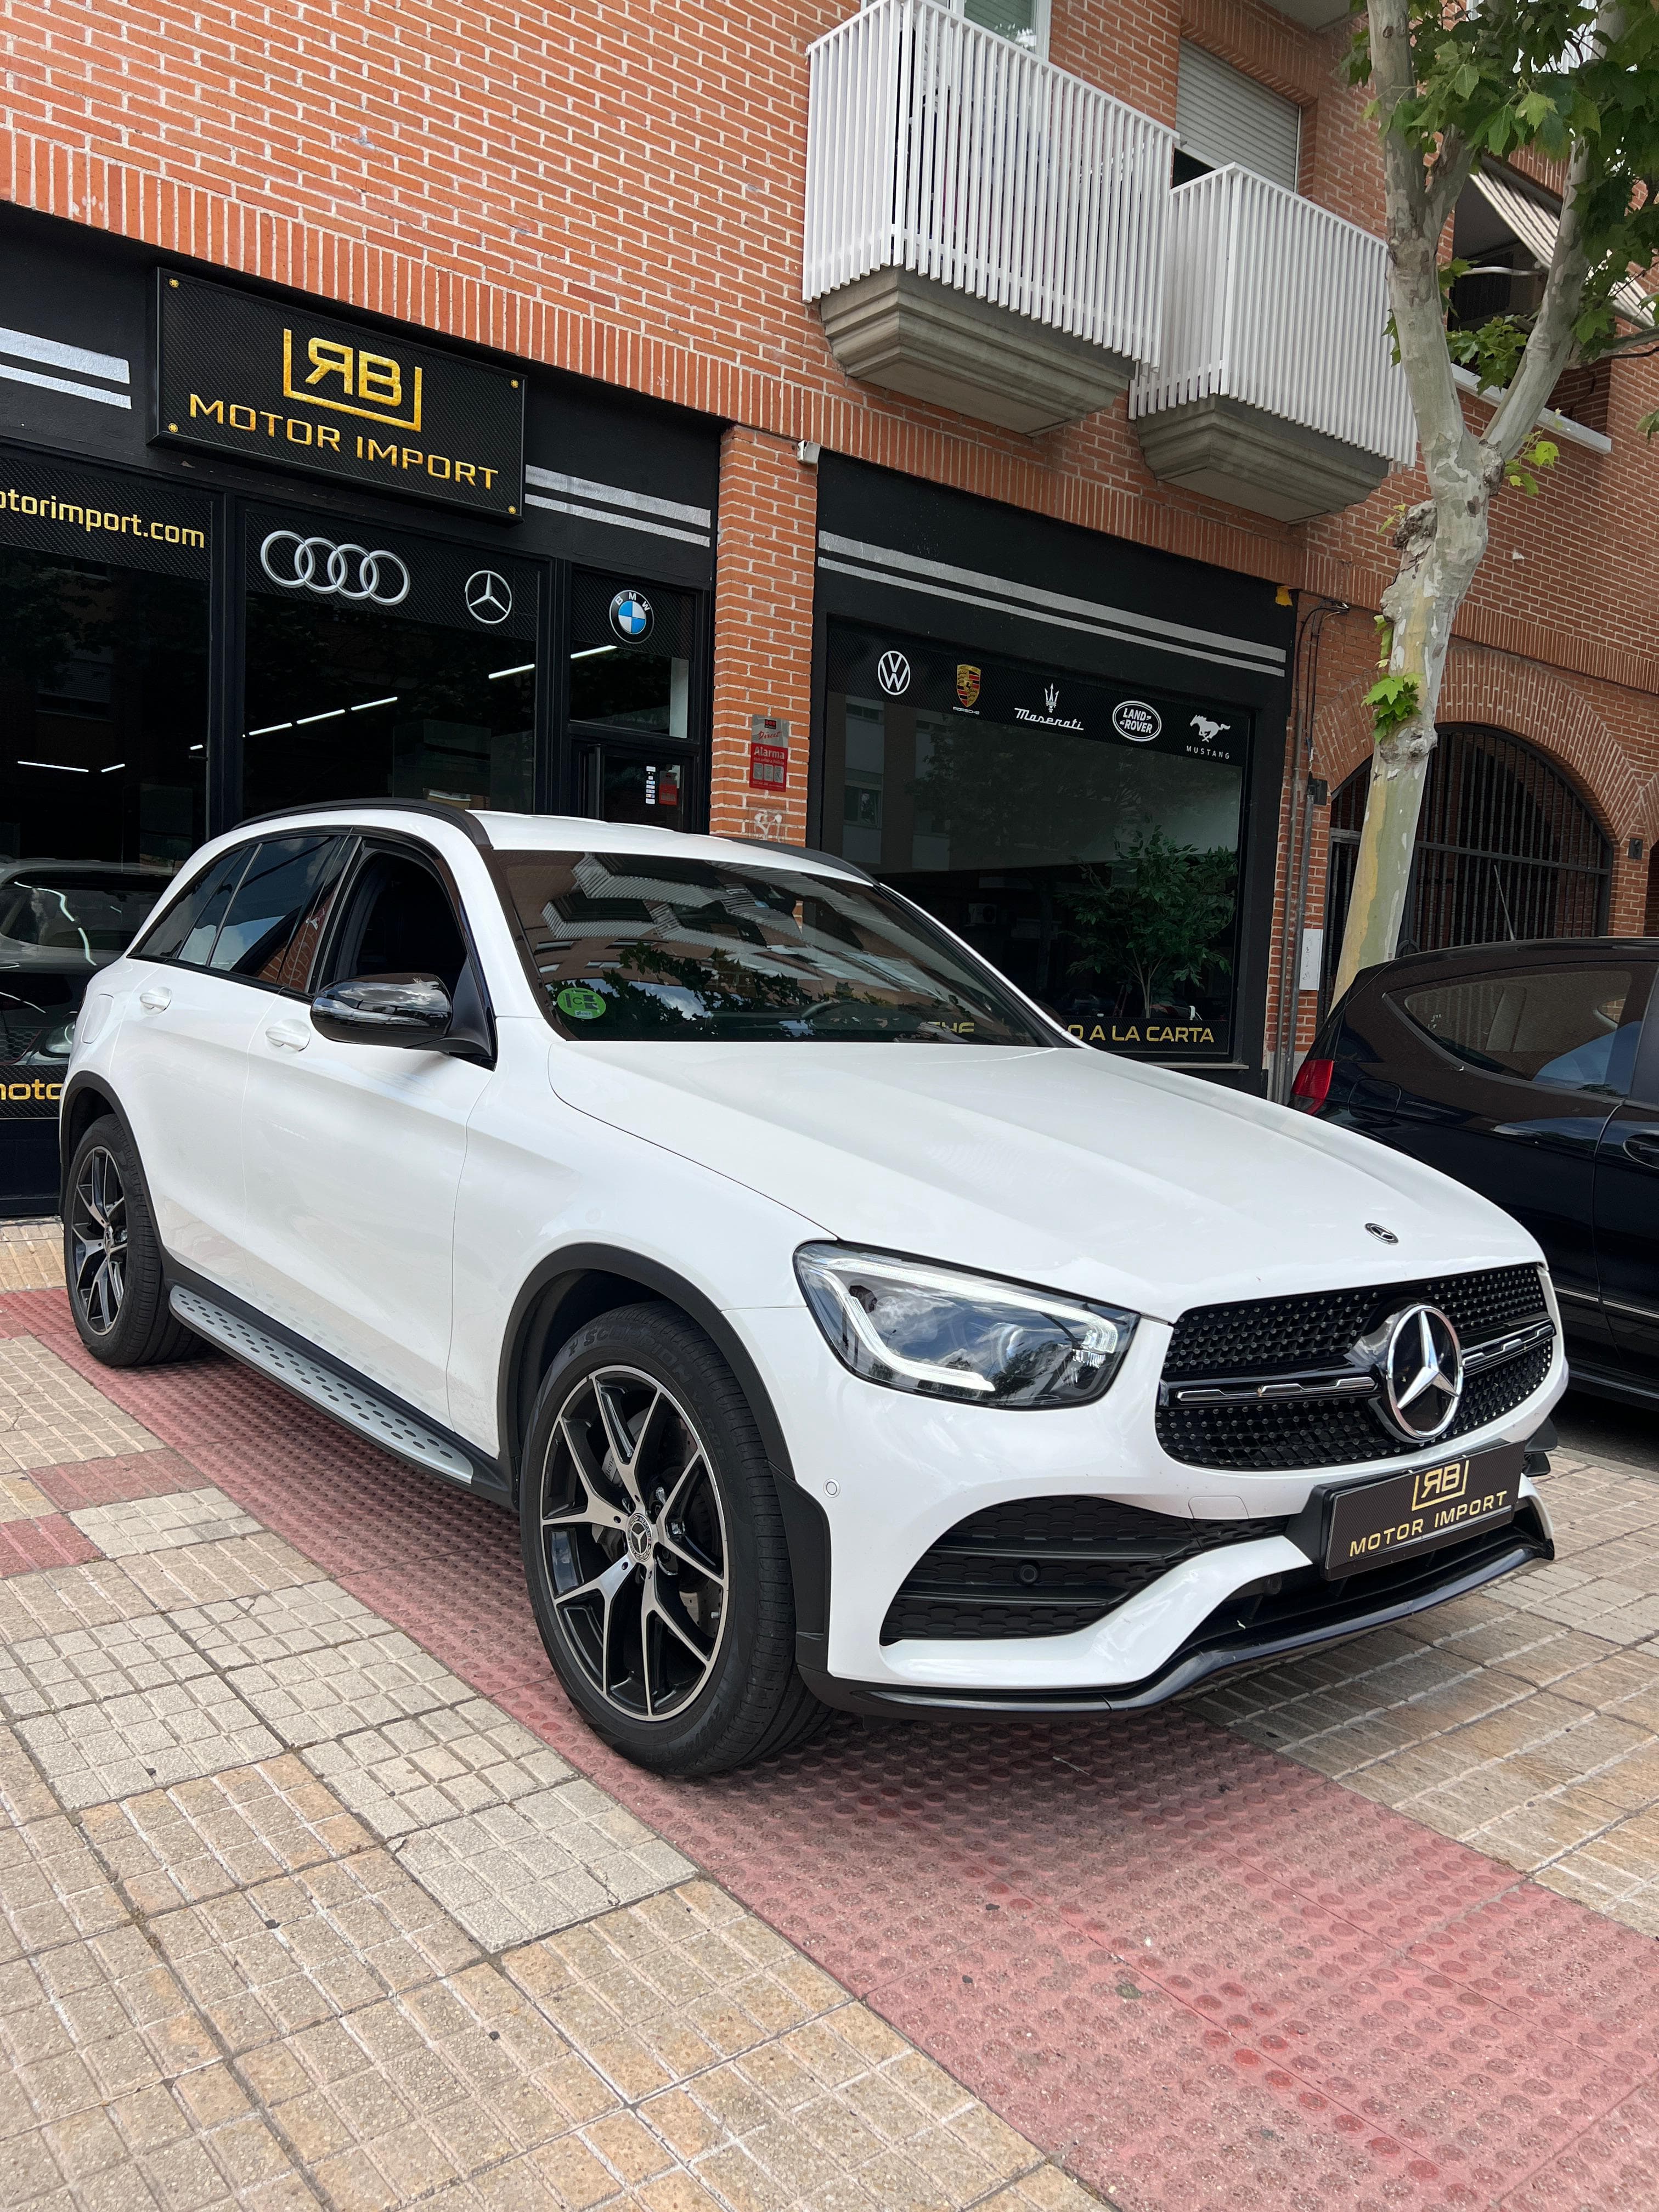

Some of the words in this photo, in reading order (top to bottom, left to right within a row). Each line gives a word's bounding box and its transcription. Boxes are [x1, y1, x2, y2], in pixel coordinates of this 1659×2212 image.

[190, 393, 341, 452] MOTOR
[357, 436, 498, 490] IMPORT
[615, 592, 651, 611] BMW
[1014, 708, 1084, 731] Maserati
[1122, 708, 1147, 721] LAND
[1124, 719, 1153, 734] ROVER
[754, 746, 785, 760] Alarma
[1186, 745, 1230, 760] MUSTANG
[1089, 1025, 1106, 1041] A
[1111, 1025, 1141, 1041] LA
[1146, 1026, 1215, 1043] CARTA
[0, 1079, 63, 1100] oto
[1350, 1519, 1424, 1557] MOTOR
[1434, 1491, 1508, 1528] IMPORT
